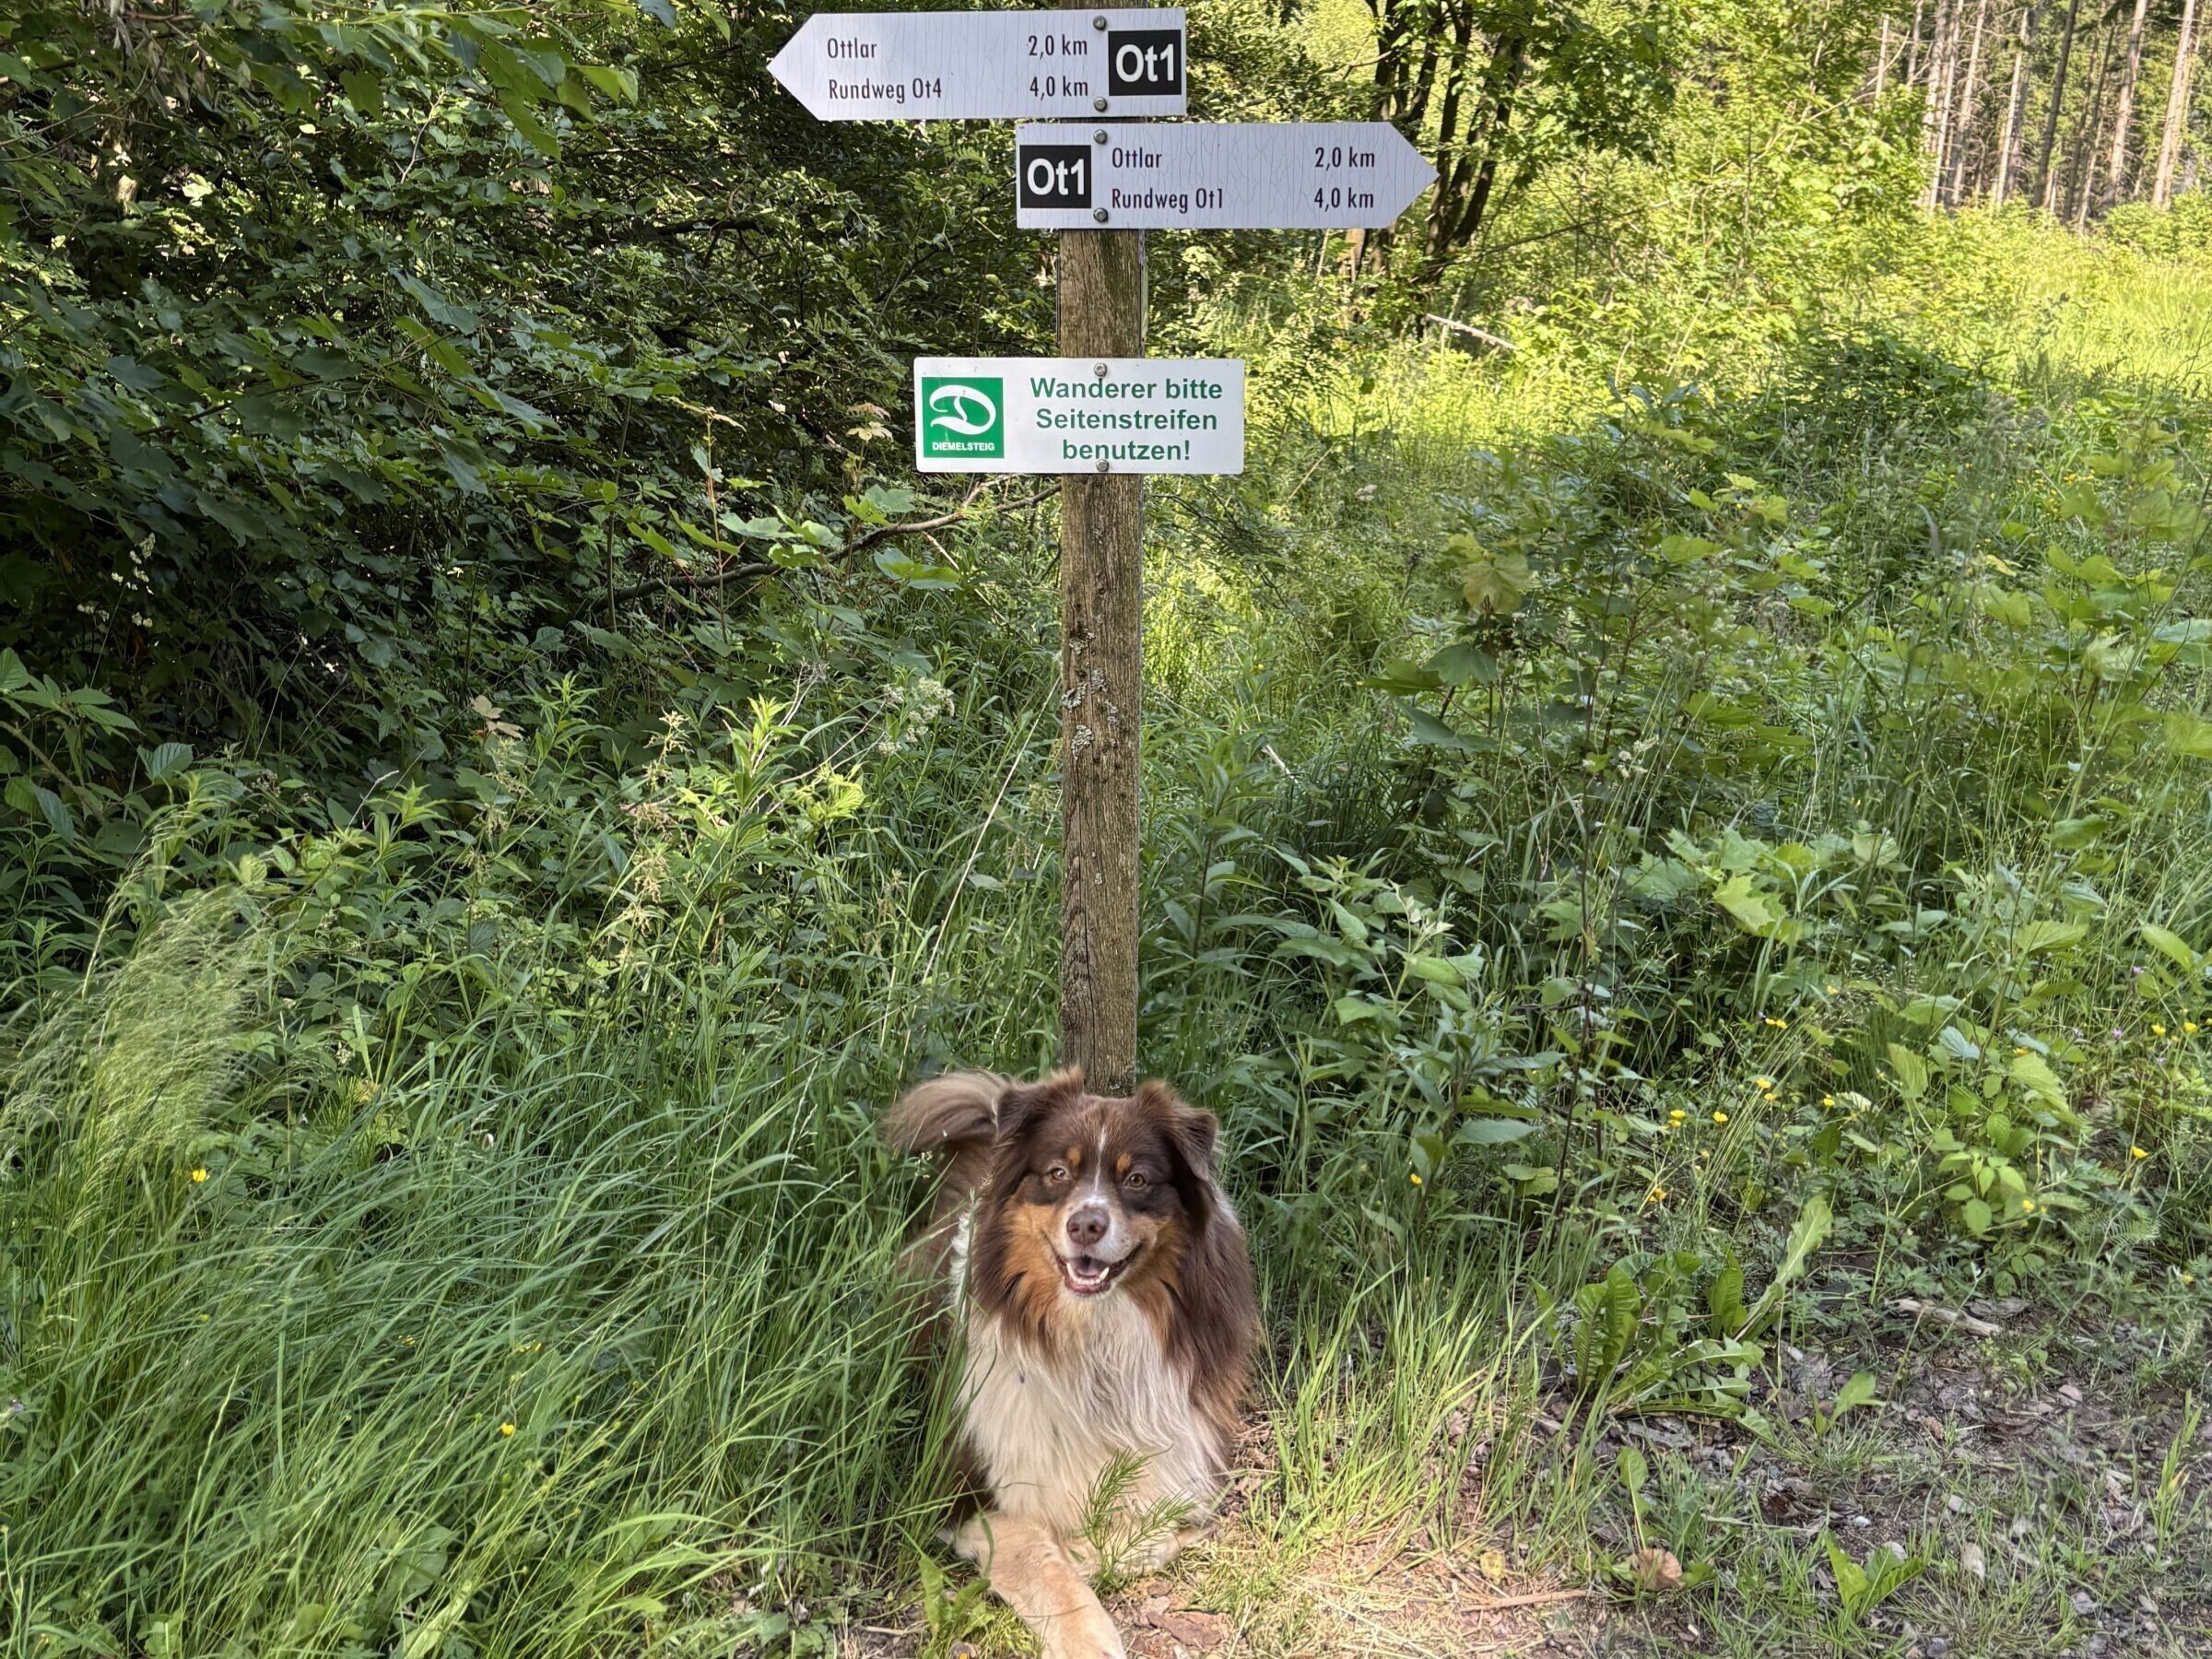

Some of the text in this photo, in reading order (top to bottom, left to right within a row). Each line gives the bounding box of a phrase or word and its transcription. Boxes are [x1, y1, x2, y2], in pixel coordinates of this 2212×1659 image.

[827, 38, 877, 59] Ottlar
[1028, 35, 1088, 60] 2,0 km
[1114, 43, 1176, 83] Ot1
[829, 78, 942, 104] Rundweg Ot4
[1029, 76, 1088, 101] 4,0 km
[1112, 147, 1162, 169] Ottlar
[1314, 147, 1375, 171] 2,0 km
[1026, 158, 1085, 195] Ot1
[1112, 188, 1224, 214] Rundweg Ot1
[1313, 188, 1374, 212] 4,0 km
[1030, 377, 1223, 399] Wanderer bitte
[1036, 408, 1218, 430] Seitenstreifen
[932, 441, 995, 452] DIEMELSTEIG
[1063, 440, 1190, 461] benutzen!
